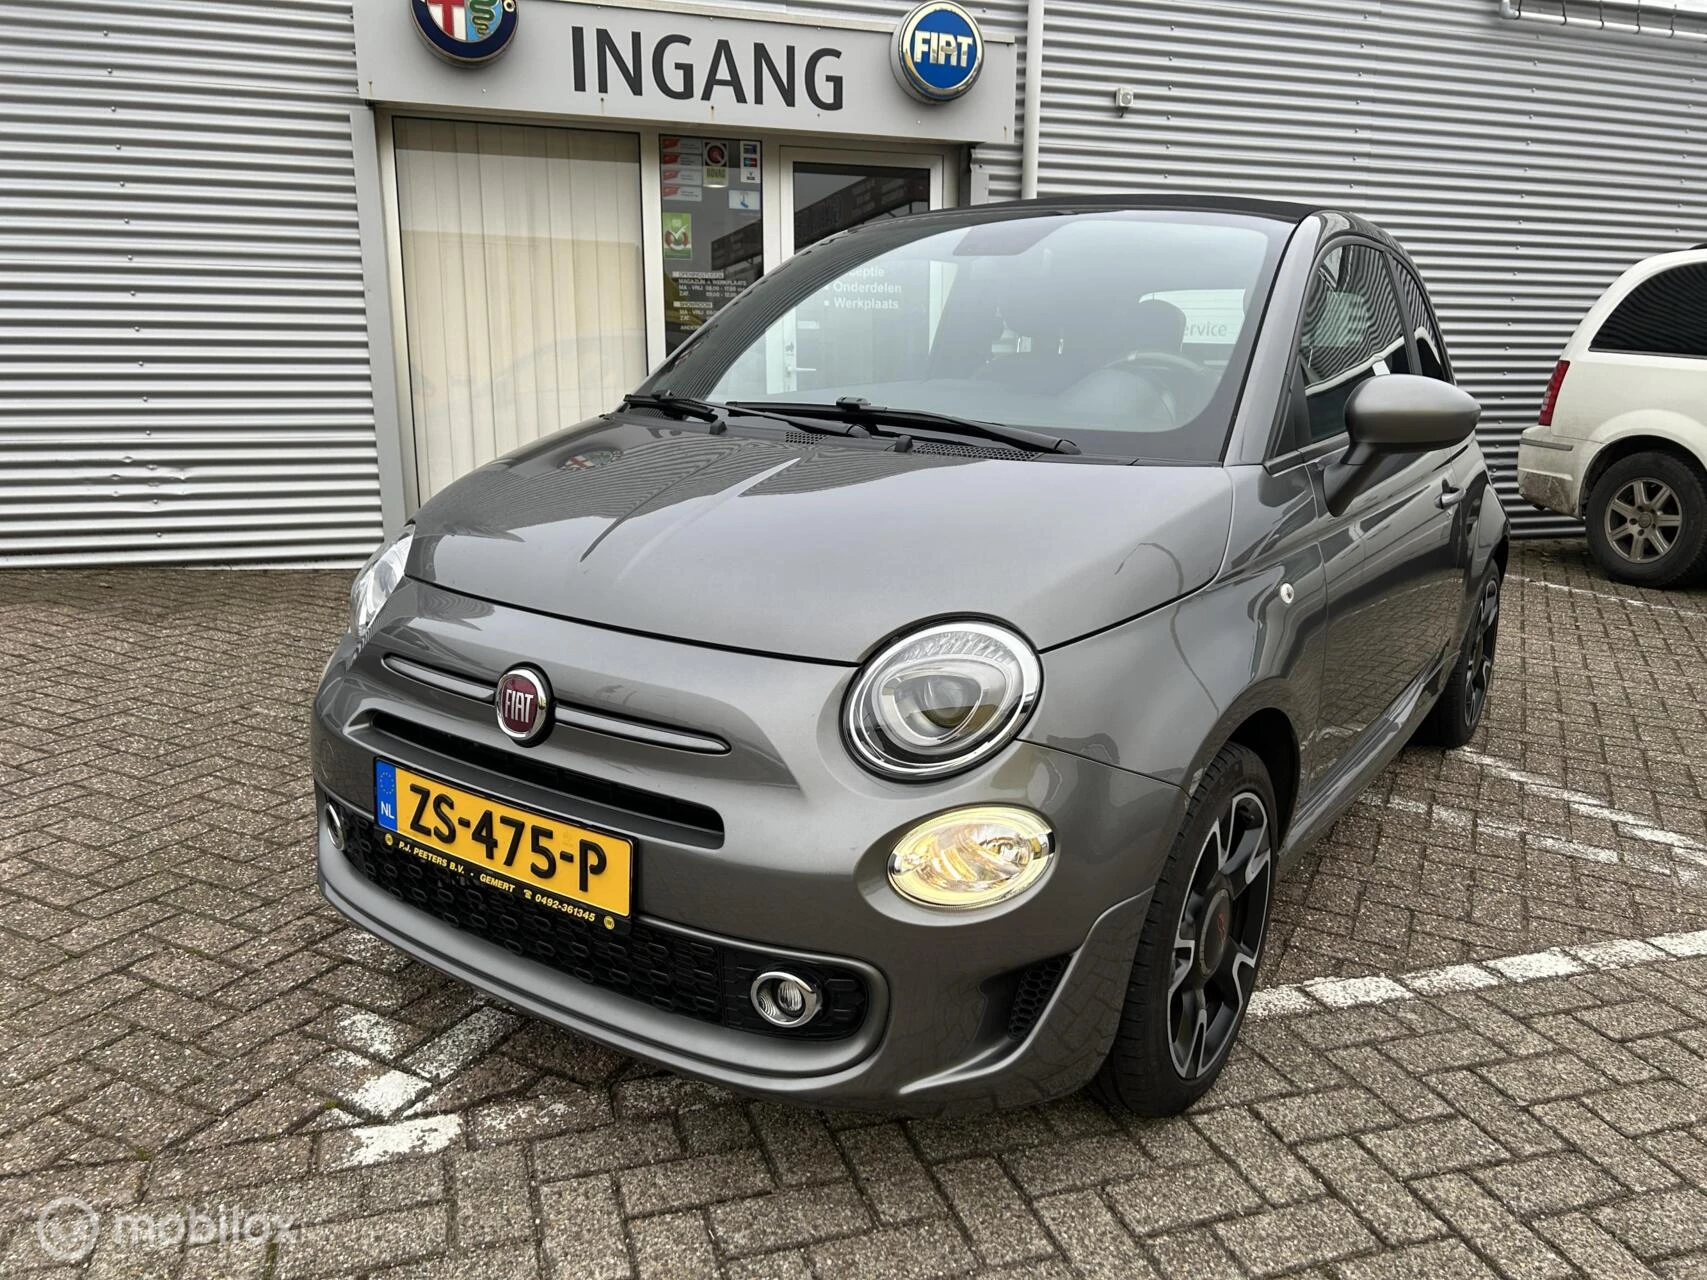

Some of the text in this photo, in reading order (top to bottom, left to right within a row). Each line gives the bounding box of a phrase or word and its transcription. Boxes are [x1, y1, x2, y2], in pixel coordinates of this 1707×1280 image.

[914, 30, 974, 67] FIAT
[571, 26, 844, 111] INGANG
[848, 265, 885, 279] ceptie
[833, 281, 902, 293] Onderdelen
[833, 297, 899, 310] Werkplaats
[1183, 321, 1228, 337] ervice
[505, 689, 534, 723] FIAT
[380, 801, 395, 820] NL
[409, 783, 607, 893] ZS-475-P
[398, 841, 596, 922] P.J. PEETERS B.V. GEMERT 0492-361345
